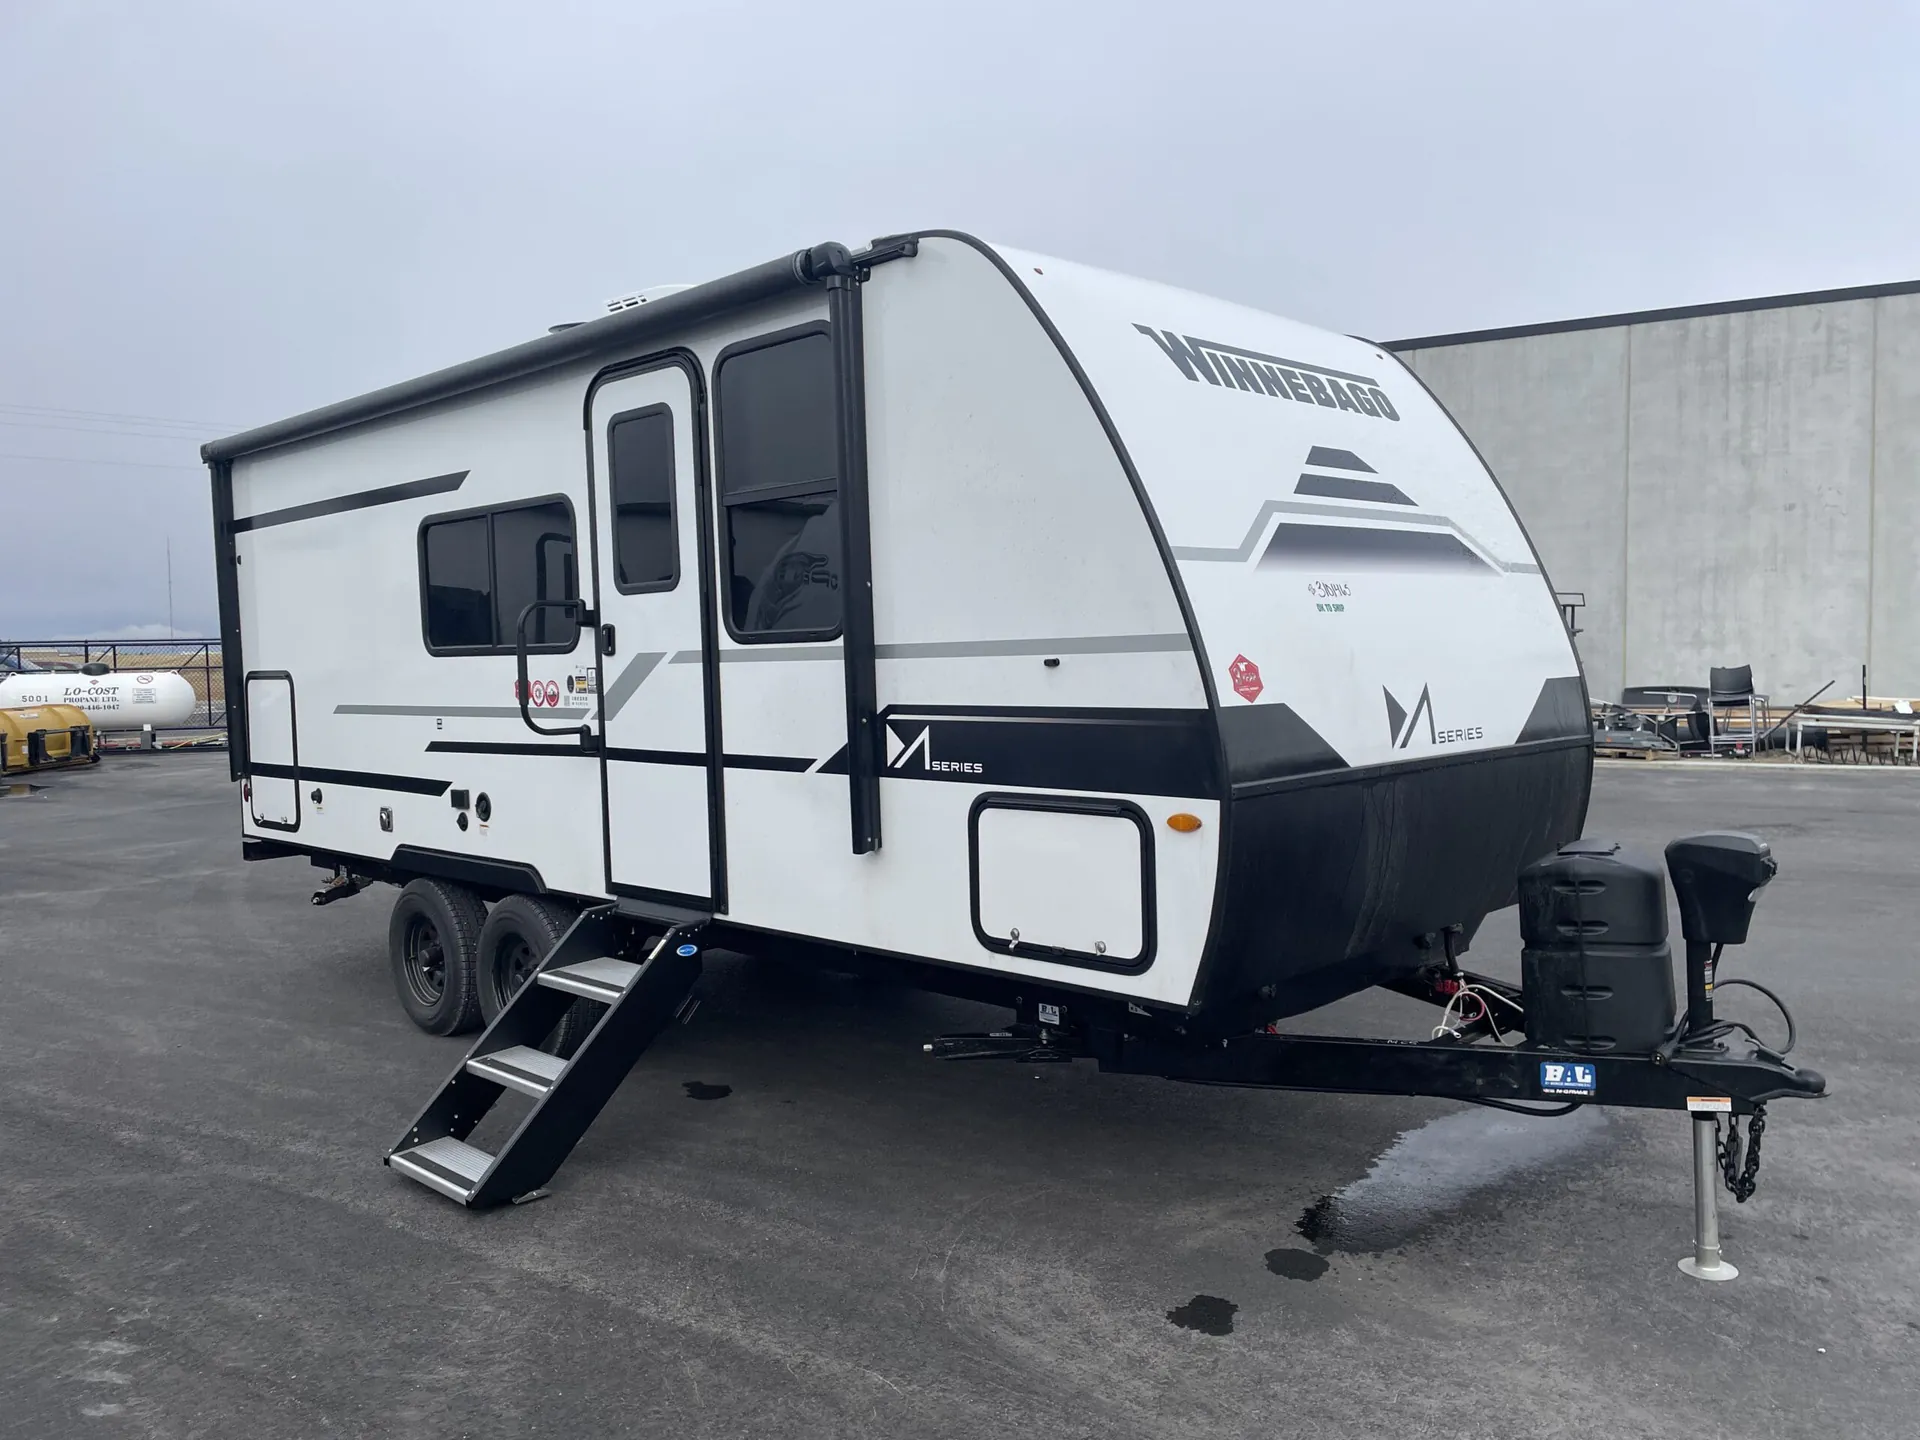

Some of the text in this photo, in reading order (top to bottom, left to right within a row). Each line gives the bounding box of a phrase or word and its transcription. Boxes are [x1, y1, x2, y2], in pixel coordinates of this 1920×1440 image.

[1131, 323, 1400, 421] WINNEBAGO
[64, 687, 119, 696] LO-COST
[1438, 727, 1483, 744] SERIES
[931, 761, 983, 773] SERIES
[1545, 1065, 1592, 1083] BAL
